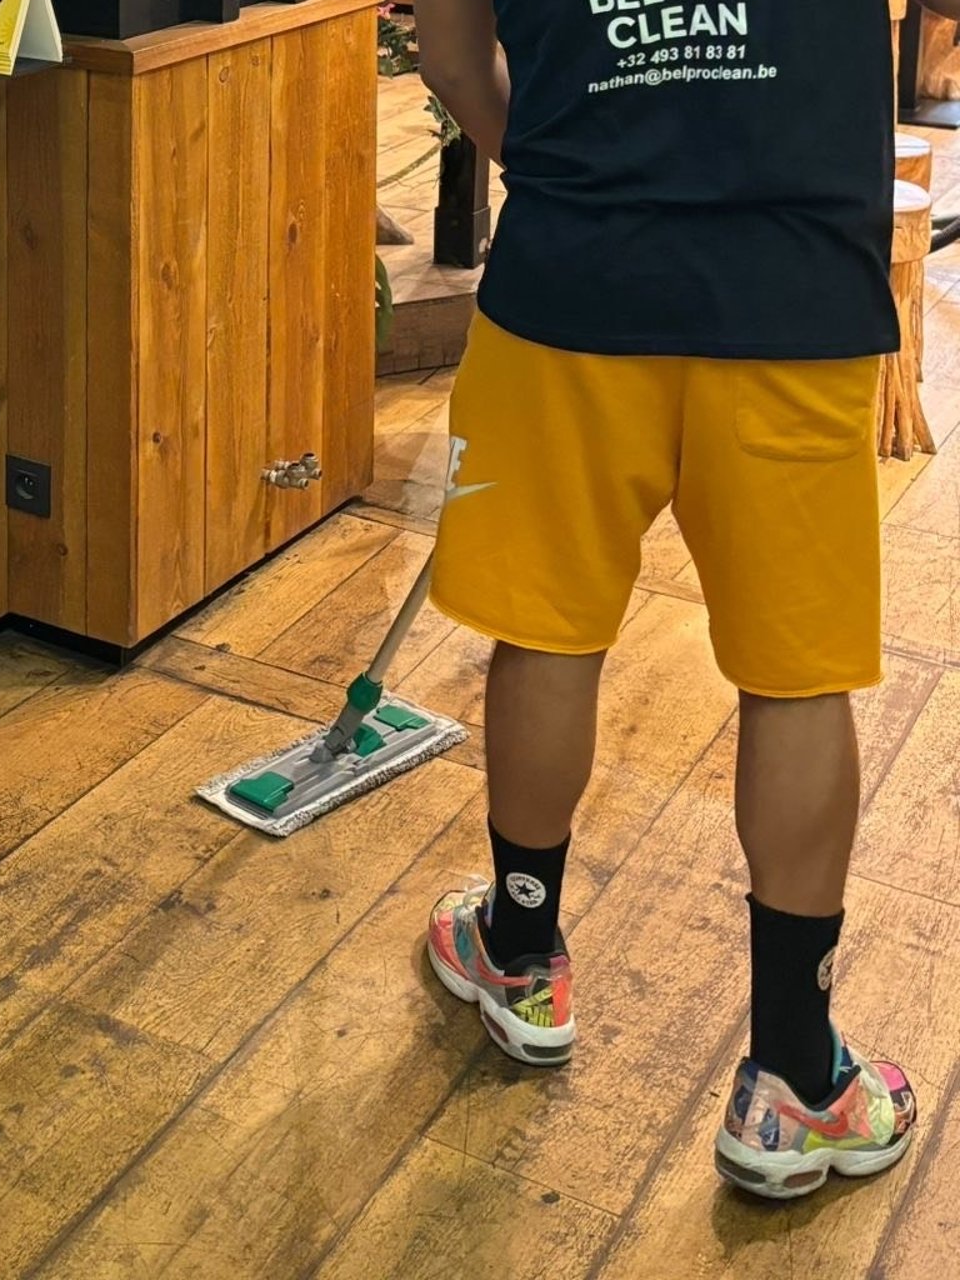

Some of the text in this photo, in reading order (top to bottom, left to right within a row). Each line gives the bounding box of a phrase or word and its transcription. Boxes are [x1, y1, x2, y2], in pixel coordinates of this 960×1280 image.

[607, 2, 748, 49] CLEAN
[617, 45, 746, 69] +32 493 81 83 81
[588, 63, 778, 94] nathan@belproclean.be
